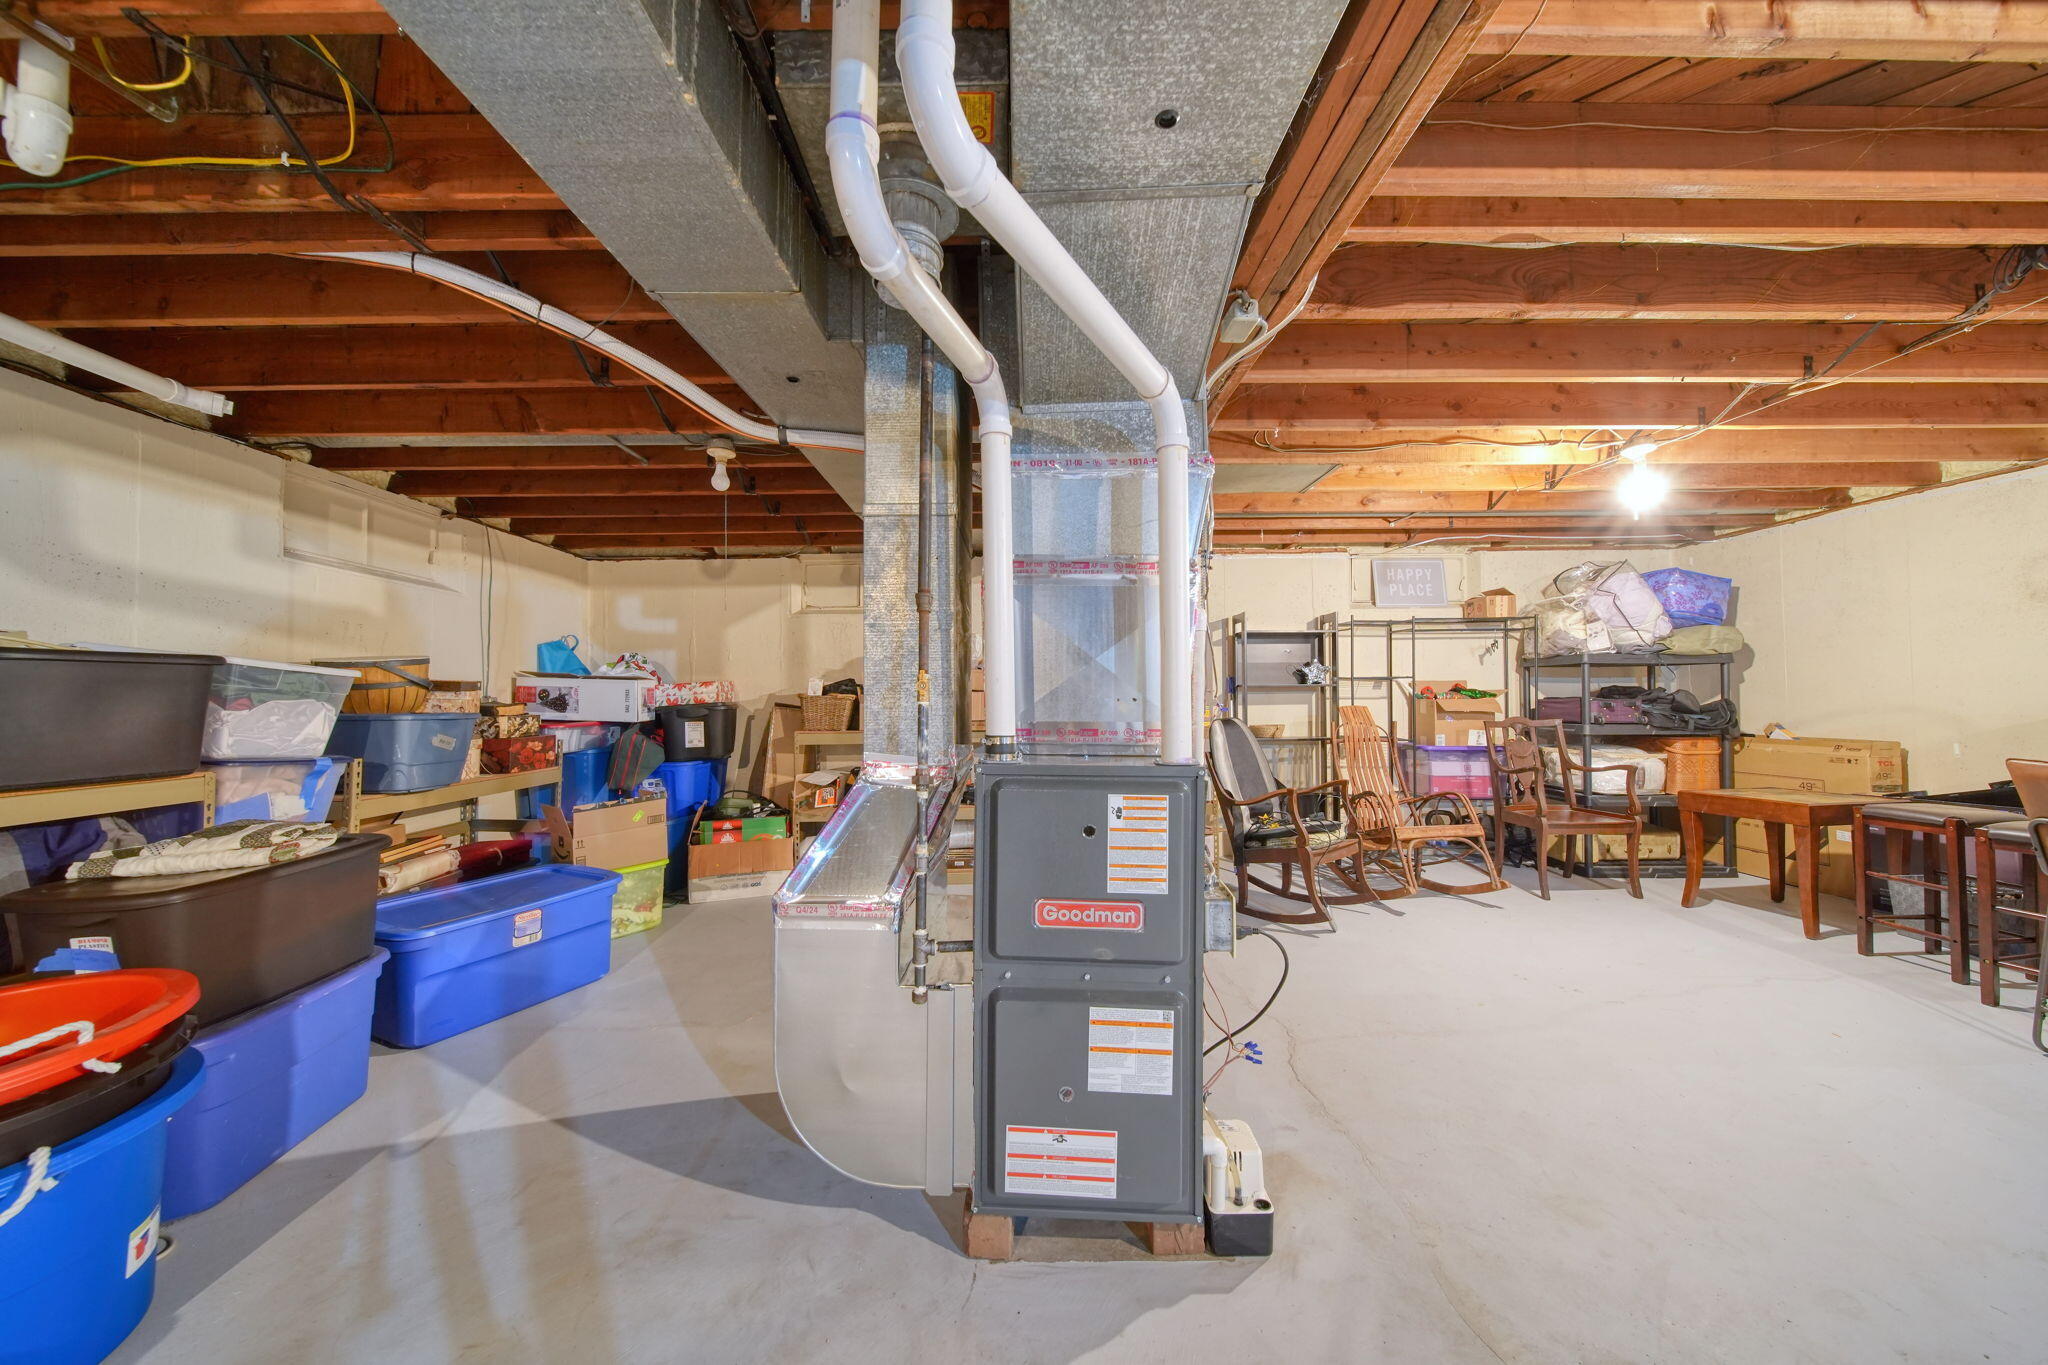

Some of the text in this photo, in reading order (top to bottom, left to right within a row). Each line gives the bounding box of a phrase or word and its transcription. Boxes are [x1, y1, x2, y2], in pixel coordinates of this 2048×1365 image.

[1386, 568, 1432, 581] HAPPY
[1389, 583, 1433, 597] PLACE
[796, 905, 818, 914] Q4/24
[1042, 905, 1136, 924] Goodman
